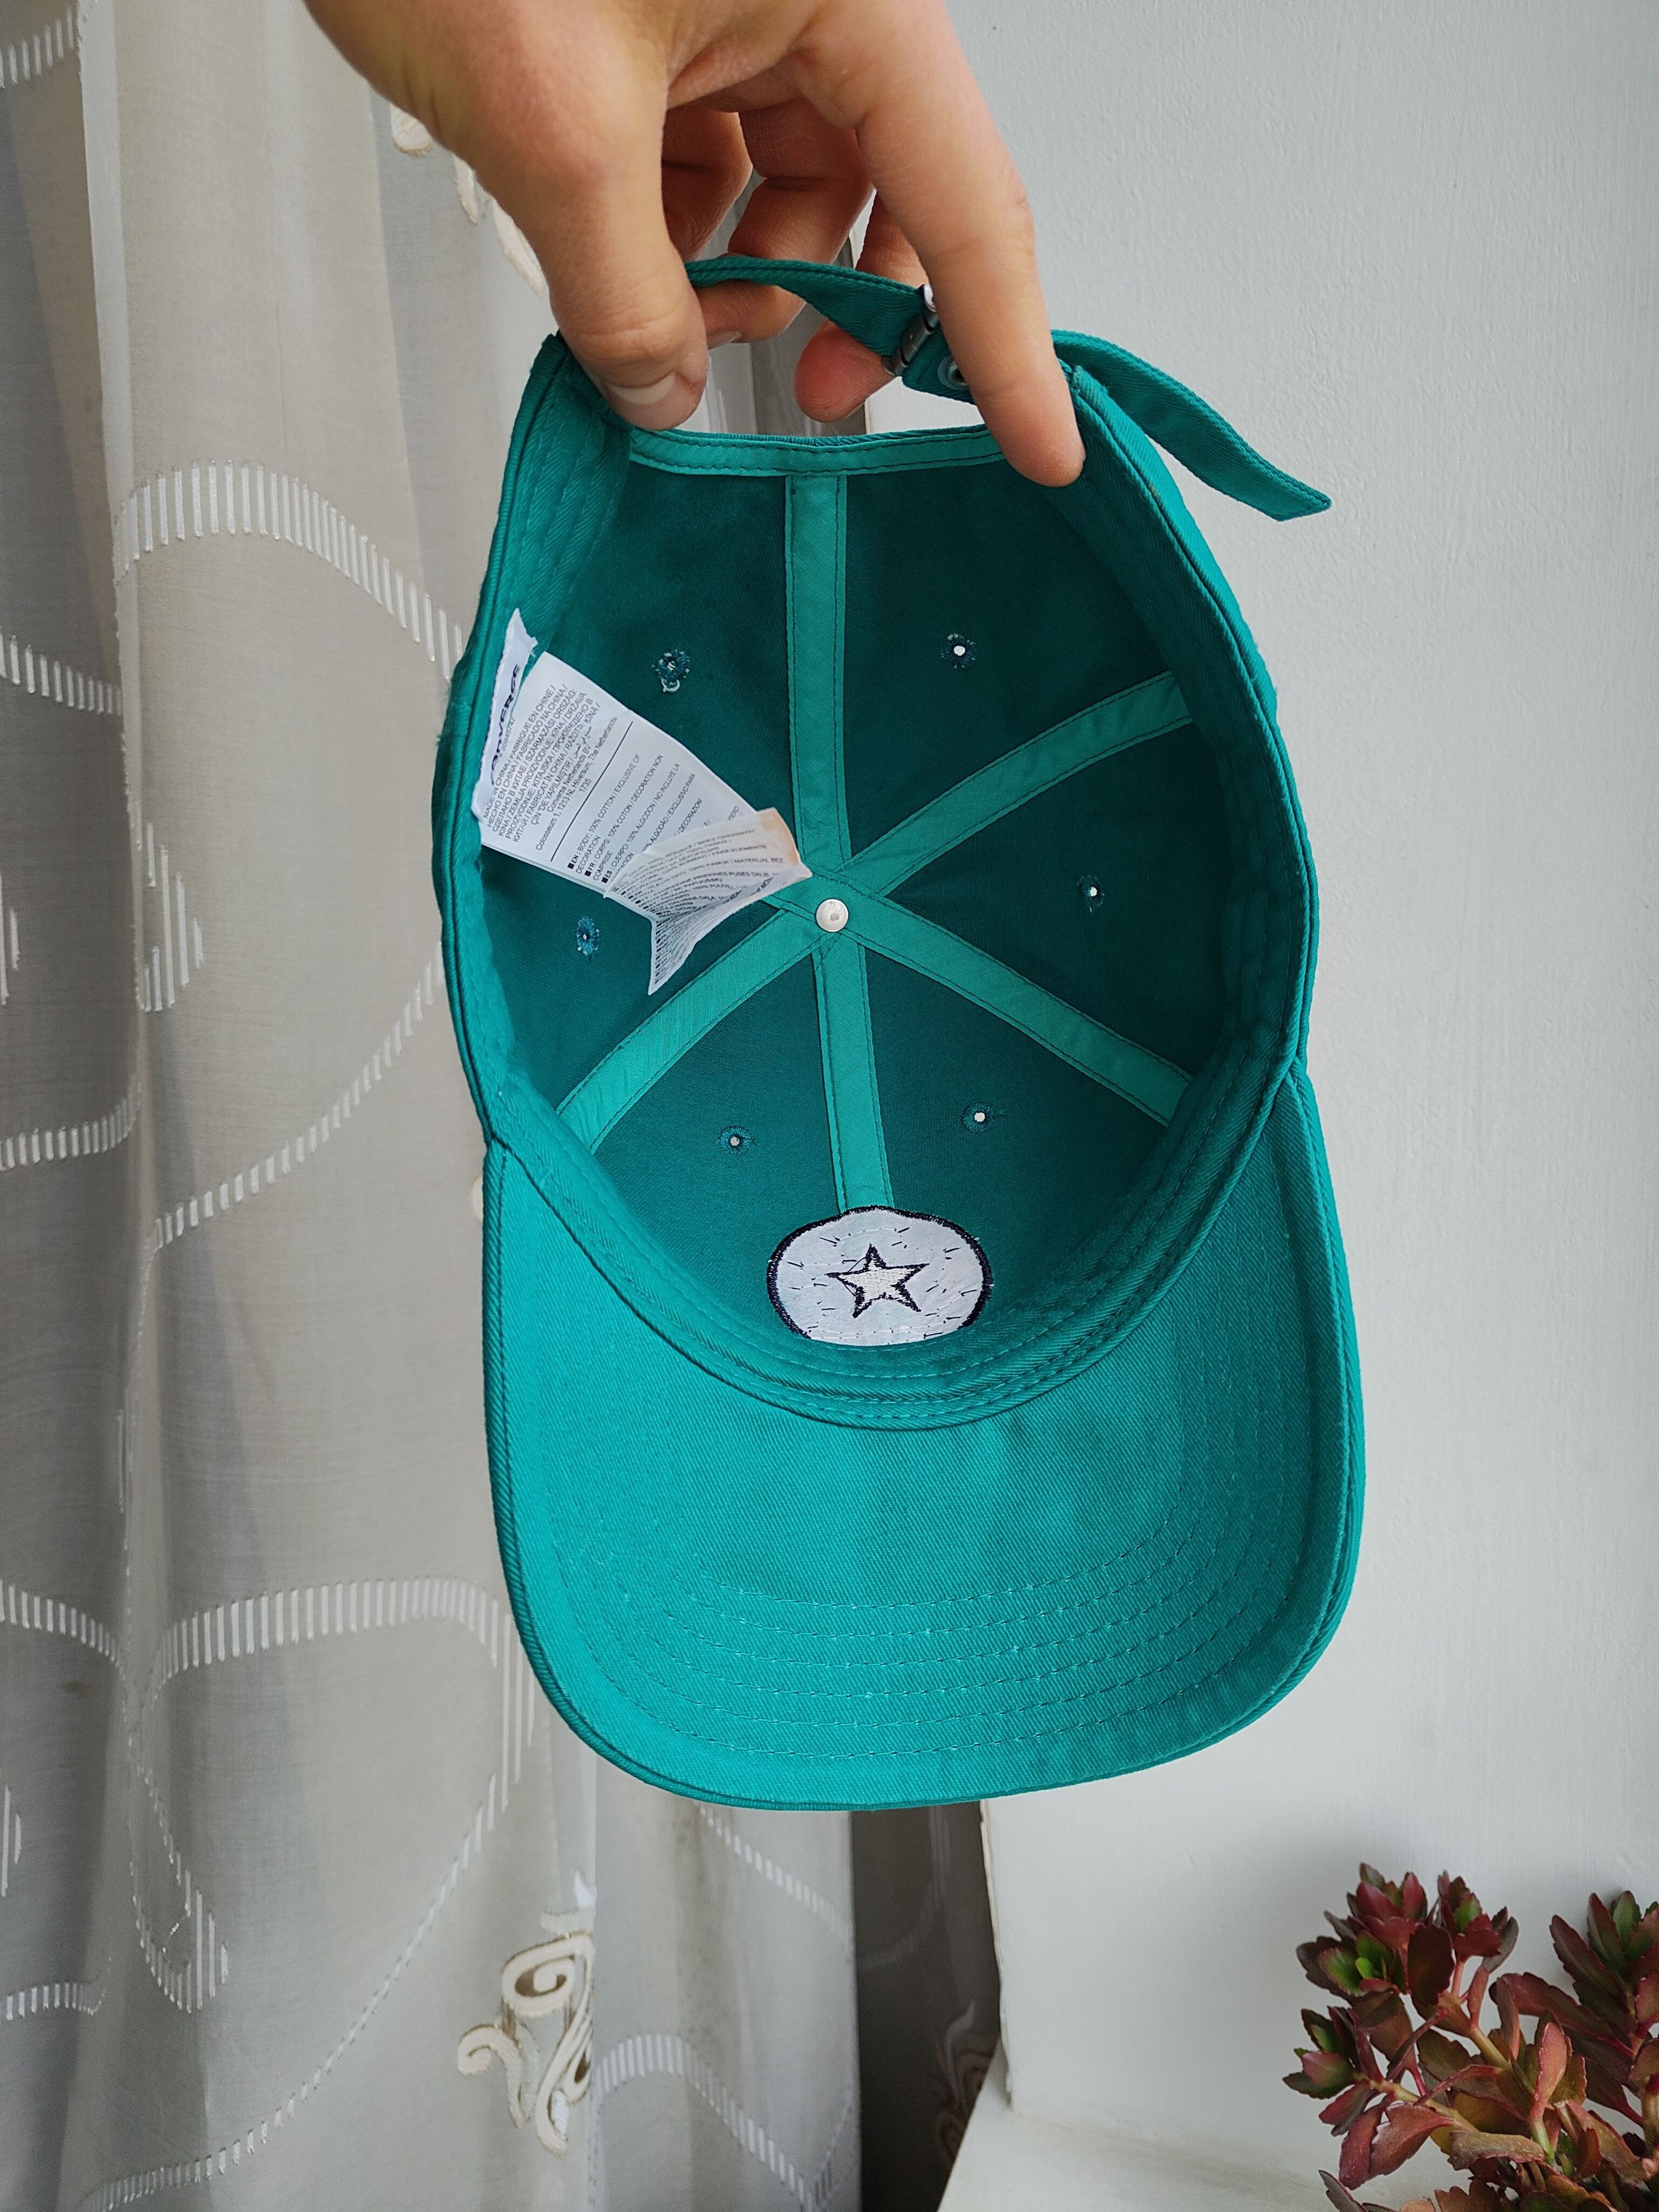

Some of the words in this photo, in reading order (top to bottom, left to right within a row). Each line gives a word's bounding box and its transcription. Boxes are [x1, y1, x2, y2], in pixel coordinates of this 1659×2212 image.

[528, 710, 539, 722] EN
[535, 688, 554, 712] CHINE
[508, 721, 532, 759] FABRIQUE
[531, 754, 554, 787] KITAJSKA
[551, 703, 590, 752] ПРОИЗВЕДЕНО
[594, 715, 617, 750] Netherlands
[486, 799, 502, 828] HECHO
[497, 787, 507, 800] EN
[502, 763, 518, 788] CHINA
[515, 719, 544, 761] FABRICADO
[539, 708, 552, 721] NA
[546, 687, 566, 711] CHINA
[491, 795, 513, 833] СДЕЛАНО
[511, 764, 527, 790] КИТАЕ
[524, 717, 556, 762] SZÁRMAZÁSI
[551, 687, 578, 720] ORSZÁG:
[497, 817, 511, 837] KINA
[507, 786, 526, 815] ZEMLJA
[549, 720, 566, 738] KINA
[563, 691, 587, 719] DRŽAVA
[587, 748, 599, 761] The
[494, 762, 509, 786] CHINA
[544, 760, 573, 801] YAPILMIŞTIR
[545, 784, 568, 813] Converse
[562, 753, 587, 786] Netherlands
[581, 743, 592, 755] BV
[570, 759, 593, 788] Hilversum,
[579, 777, 592, 793] 1735
[482, 795, 495, 819] MADE
[492, 786, 499, 796] IN
[512, 817, 528, 842] КИТАЙ
[526, 781, 549, 815] FABRICAT
[549, 751, 566, 774] CHINA
[557, 795, 570, 811] 1213
[565, 787, 576, 797] NL
[648, 815, 669, 843] ALGODÃO
[667, 785, 690, 815] EXCLUSIVO
[684, 772, 696, 787] PARA
[552, 810, 562, 818] 1,
[570, 854, 579, 864] EN
[588, 817, 602, 834] 100%
[597, 794, 616, 819] COTTON
[614, 762, 636, 793] EXCLUSIVE
[631, 753, 641, 763] OF
[587, 861, 595, 872] FR
[607, 822, 620, 838] 100%
[616, 803, 633, 824] COTON
[630, 766, 656, 802] DECORATION
[652, 753, 664, 769] NON
[604, 869, 612, 878] ES
[626, 828, 638, 843] 100%
[653, 791, 664, 801] NO
[659, 769, 676, 793] INCLUYE
[671, 762, 680, 772] LA
[678, 798, 703, 832] DECORAZIONI
[535, 817, 557, 851] Colosseum
[575, 834, 601, 874] DECORATION
[592, 849, 614, 882] COMPRISE
